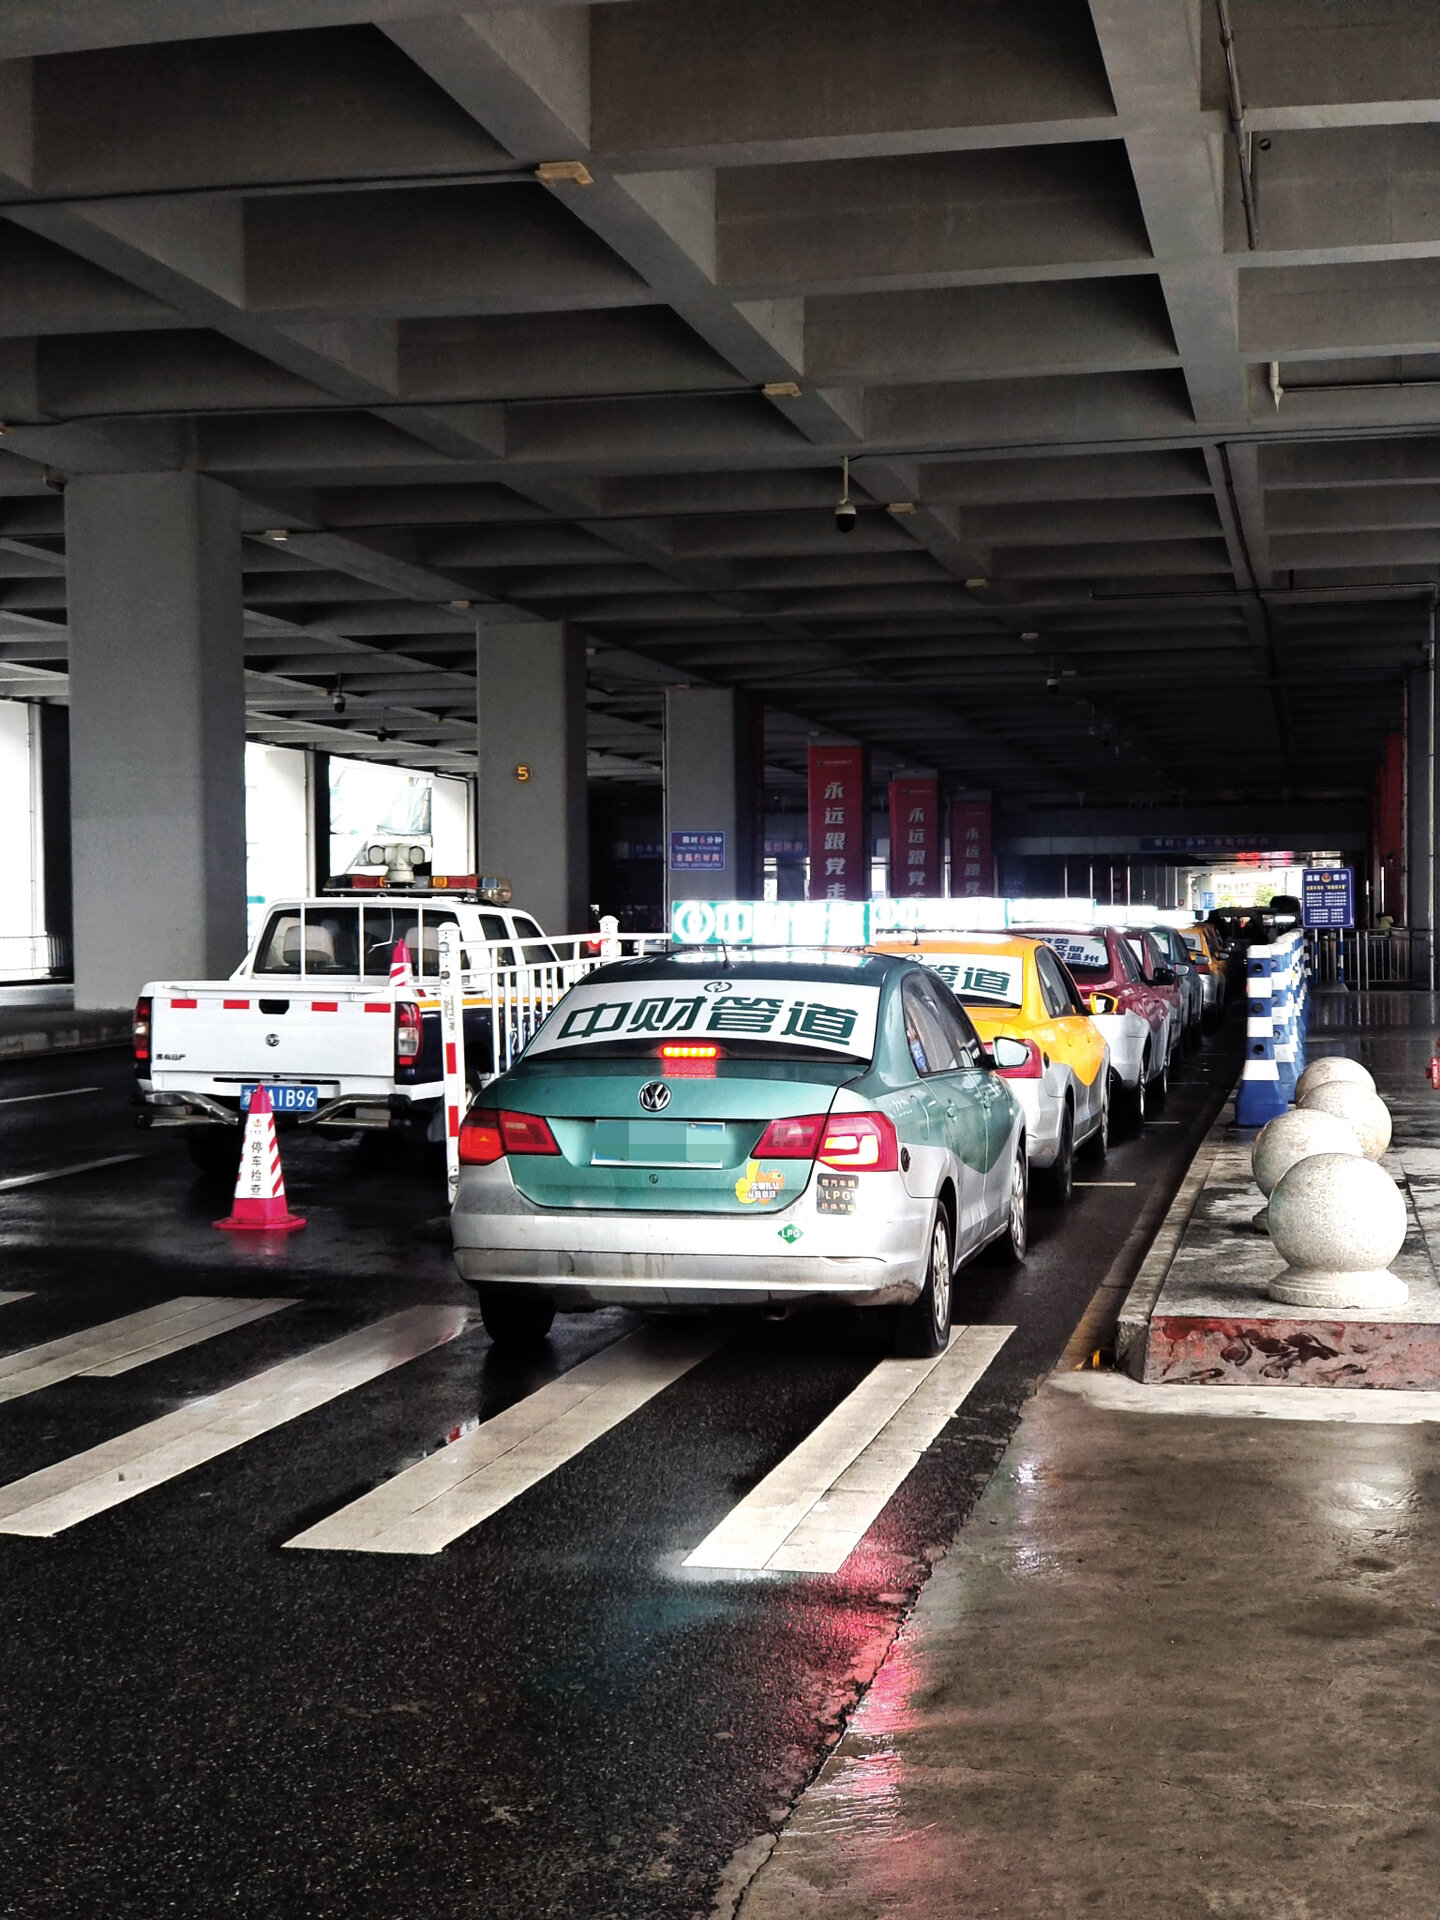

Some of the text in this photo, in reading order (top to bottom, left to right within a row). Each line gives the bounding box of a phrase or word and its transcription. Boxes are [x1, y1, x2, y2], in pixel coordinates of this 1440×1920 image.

[518, 766, 529, 780] 5
[824, 782, 847, 899] 永远跟党走
[557, 996, 858, 1045] 中财管道
[251, 1141, 262, 1195] 停车检查
[825, 1190, 851, 1200] LPG
[781, 1229, 801, 1238] LPG
